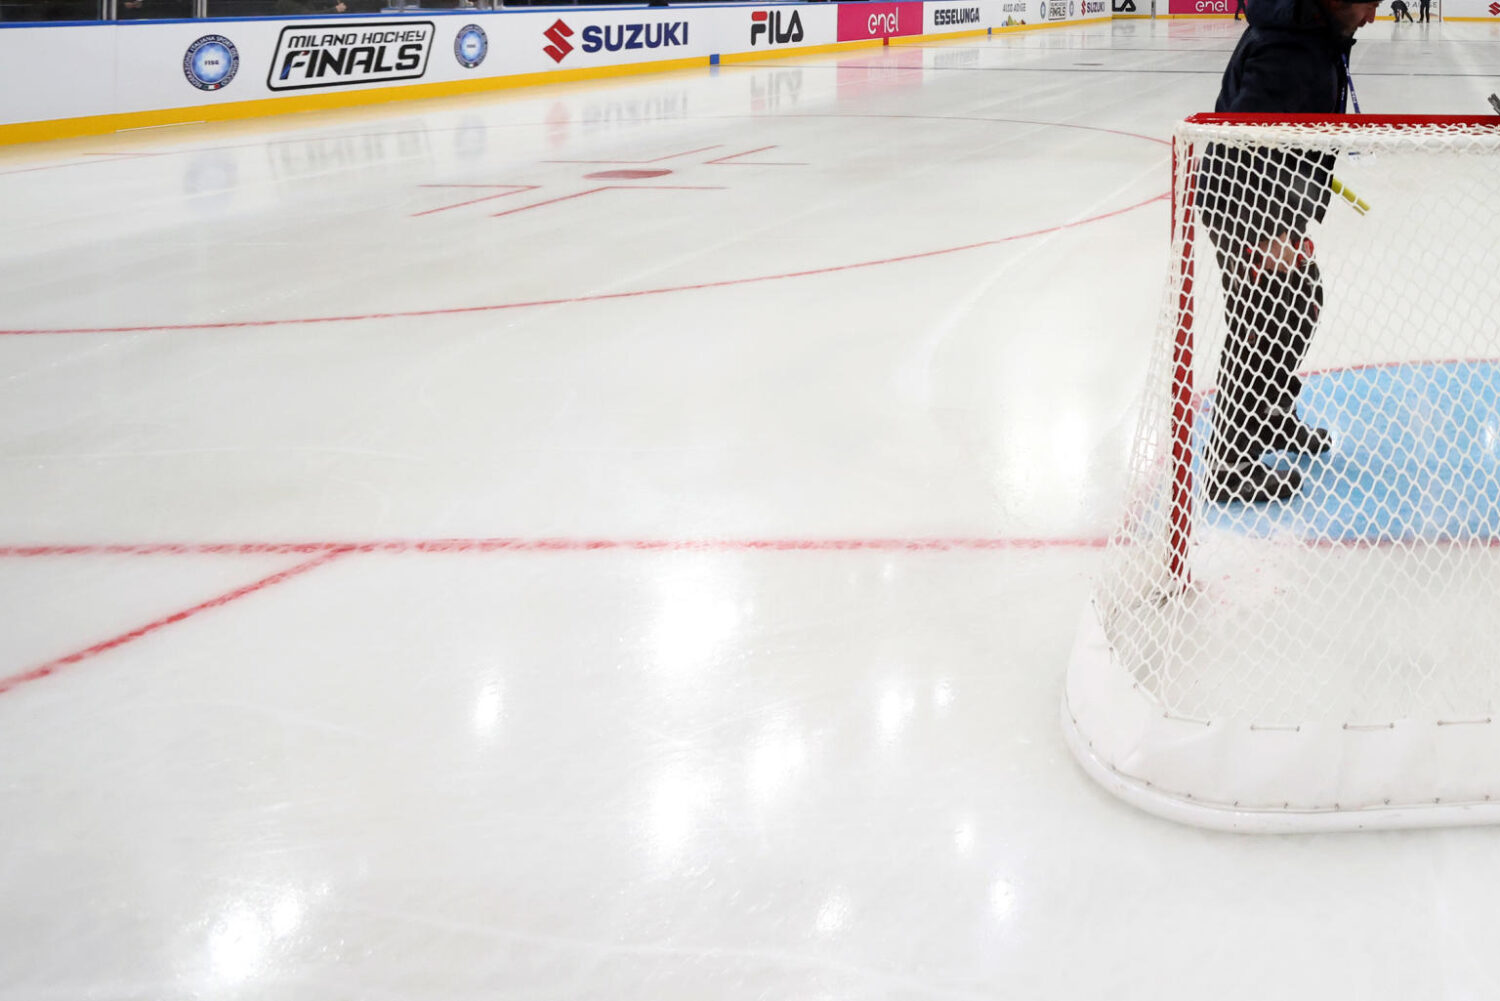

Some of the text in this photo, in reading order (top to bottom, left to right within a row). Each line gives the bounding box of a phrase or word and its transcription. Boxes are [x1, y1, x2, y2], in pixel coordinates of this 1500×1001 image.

[867, 7, 899, 35] enel
[934, 7, 980, 25] ESSELUNGA
[1087, 2, 1105, 13] SUZUKI
[288, 30, 426, 48] MILANO HOCKEY
[581, 22, 689, 52] SUZUKI
[751, 10, 804, 46] FILA
[279, 44, 422, 80] FINALS
